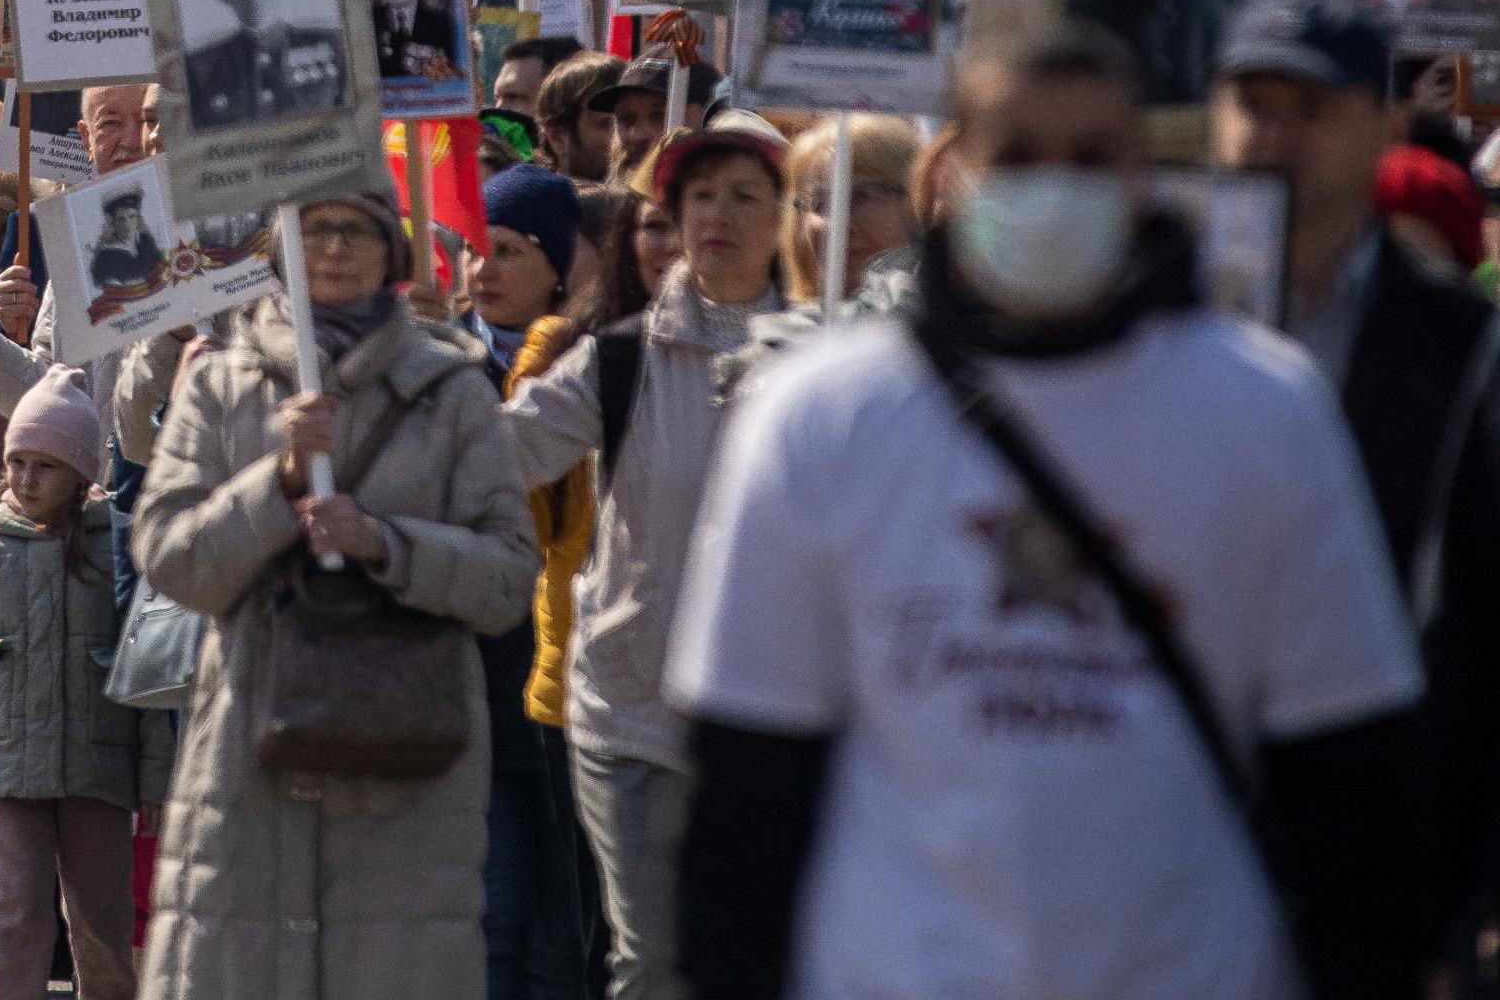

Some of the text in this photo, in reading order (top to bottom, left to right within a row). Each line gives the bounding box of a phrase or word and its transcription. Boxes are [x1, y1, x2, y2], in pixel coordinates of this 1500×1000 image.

[53, 8, 142, 24] Владимир
[47, 26, 150, 44] Федорович
[49, 137, 85, 151] Аншуко
